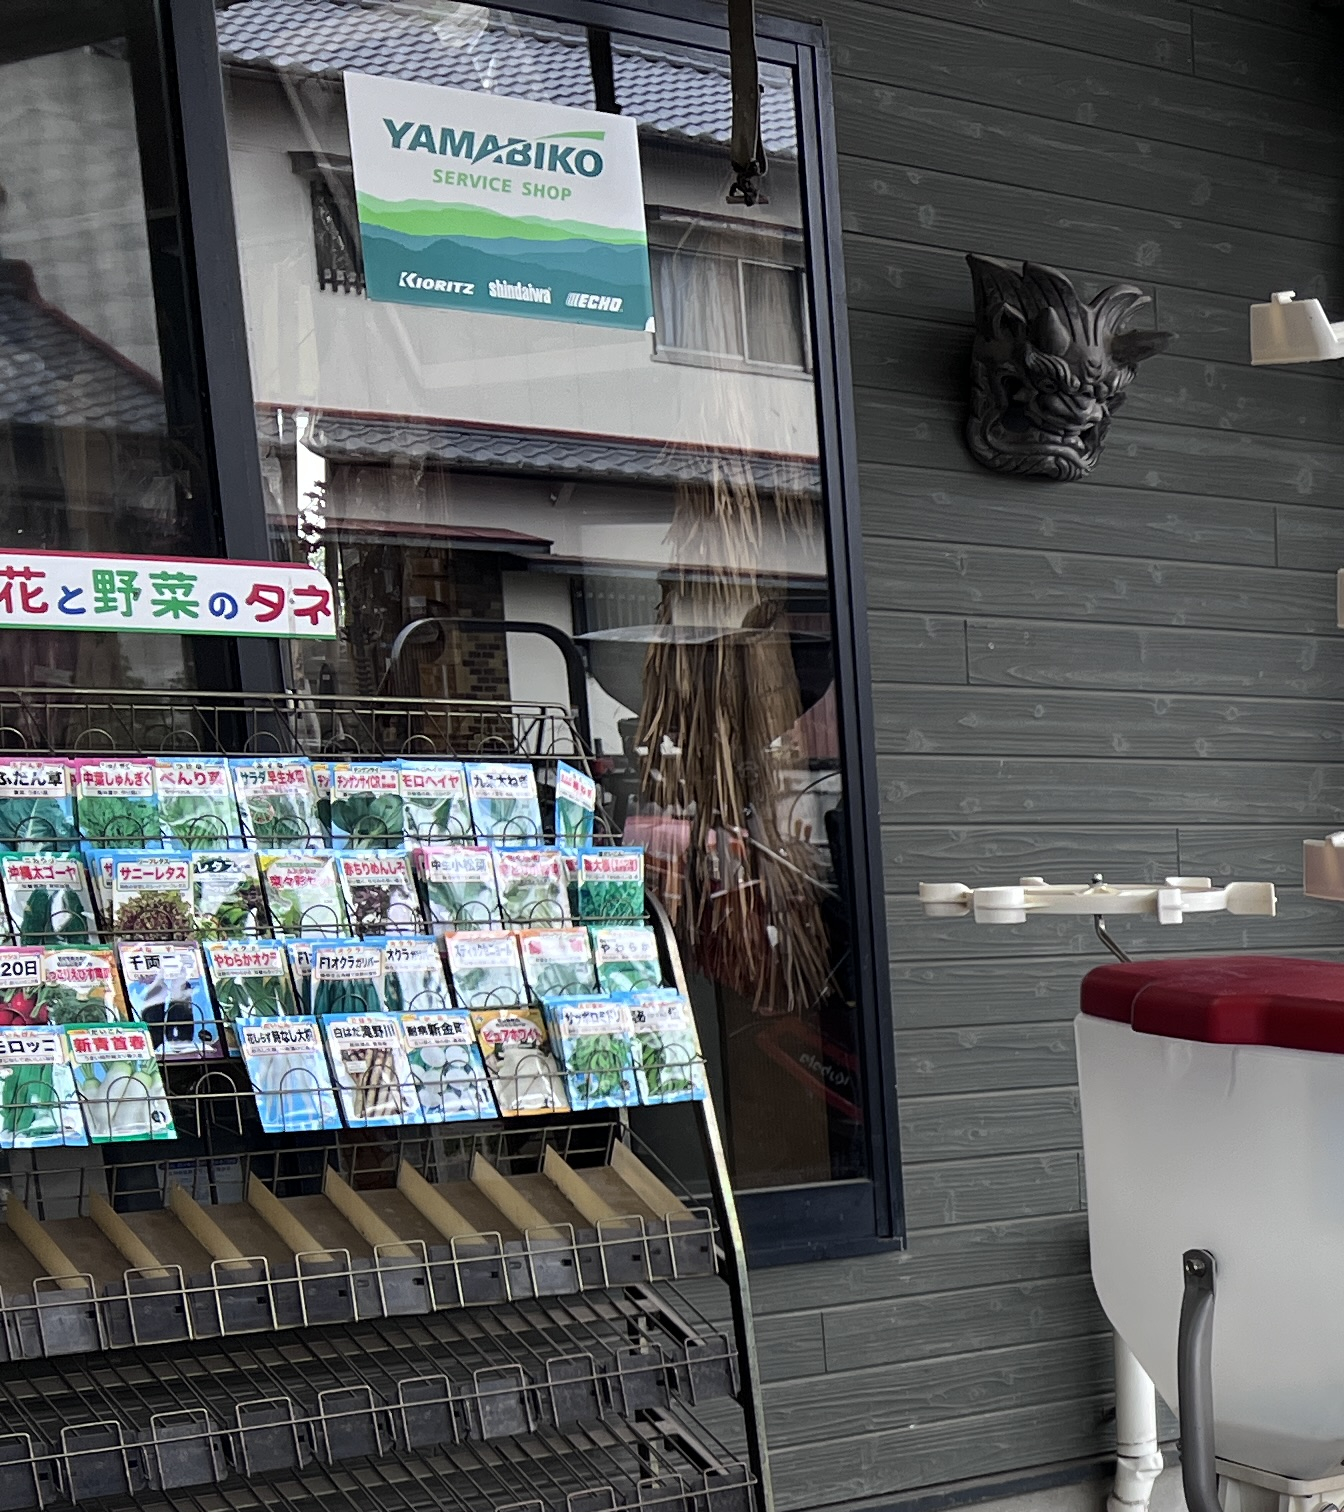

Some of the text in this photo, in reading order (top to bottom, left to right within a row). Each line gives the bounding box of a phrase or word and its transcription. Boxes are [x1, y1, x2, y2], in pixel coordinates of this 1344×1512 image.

[382, 117, 604, 178] YAMABIKO
[432, 168, 572, 201] SERVICE SHOP
[398, 271, 623, 312] KIORITZ shindaiwa ECHO
[0, 565, 331, 625] 花と野菜のタネ
[402, 774, 460, 788] モロヘイヤ
[119, 866, 187, 881] サニーレタス
